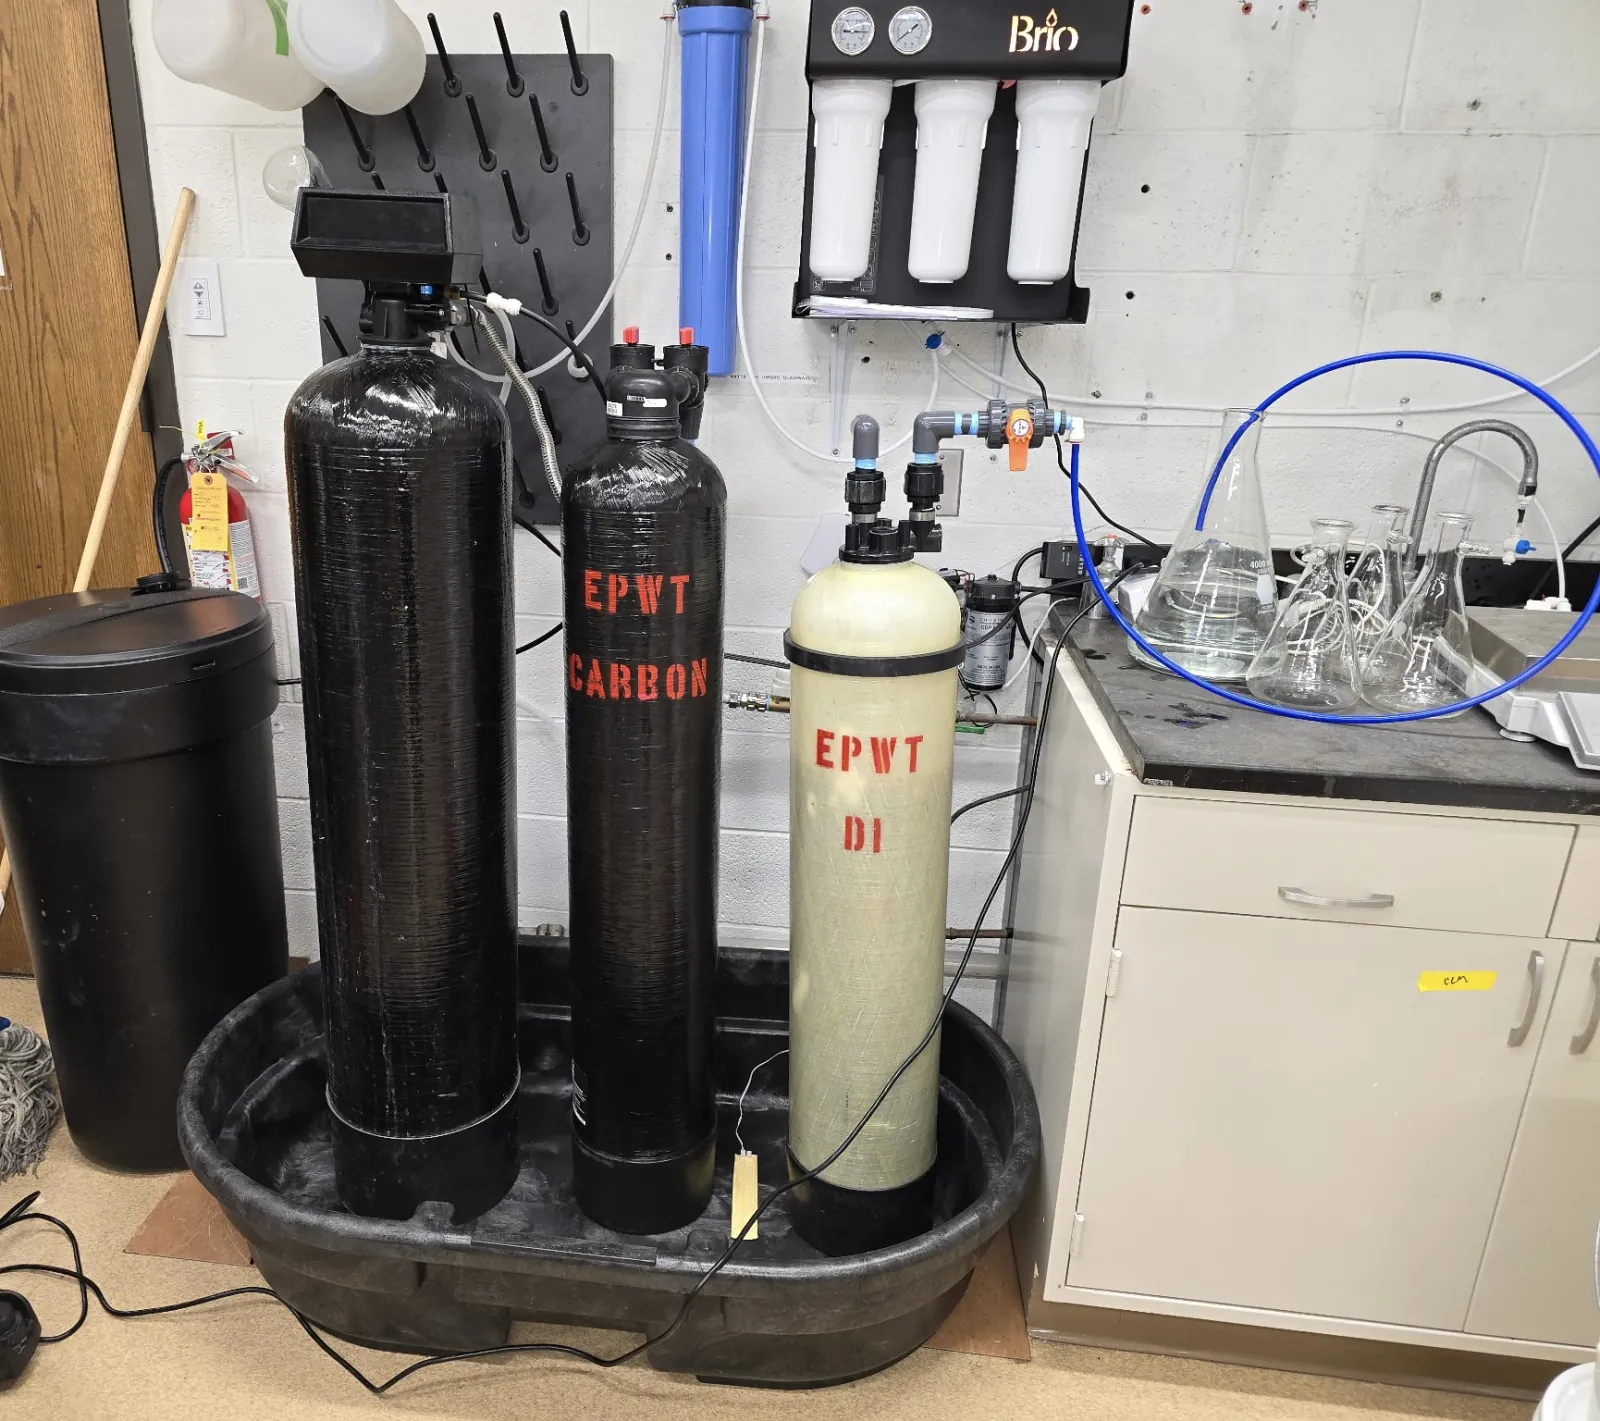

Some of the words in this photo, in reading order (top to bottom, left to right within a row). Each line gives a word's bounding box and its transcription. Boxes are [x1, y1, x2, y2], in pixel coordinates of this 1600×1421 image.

[1008, 8, 1079, 52] Brio
[1249, 560, 1266, 569] 4000
[584, 569, 690, 615] EPWT
[568, 653, 708, 701] CARBON
[816, 728, 924, 774] EPWT
[844, 815, 881, 854] DI
